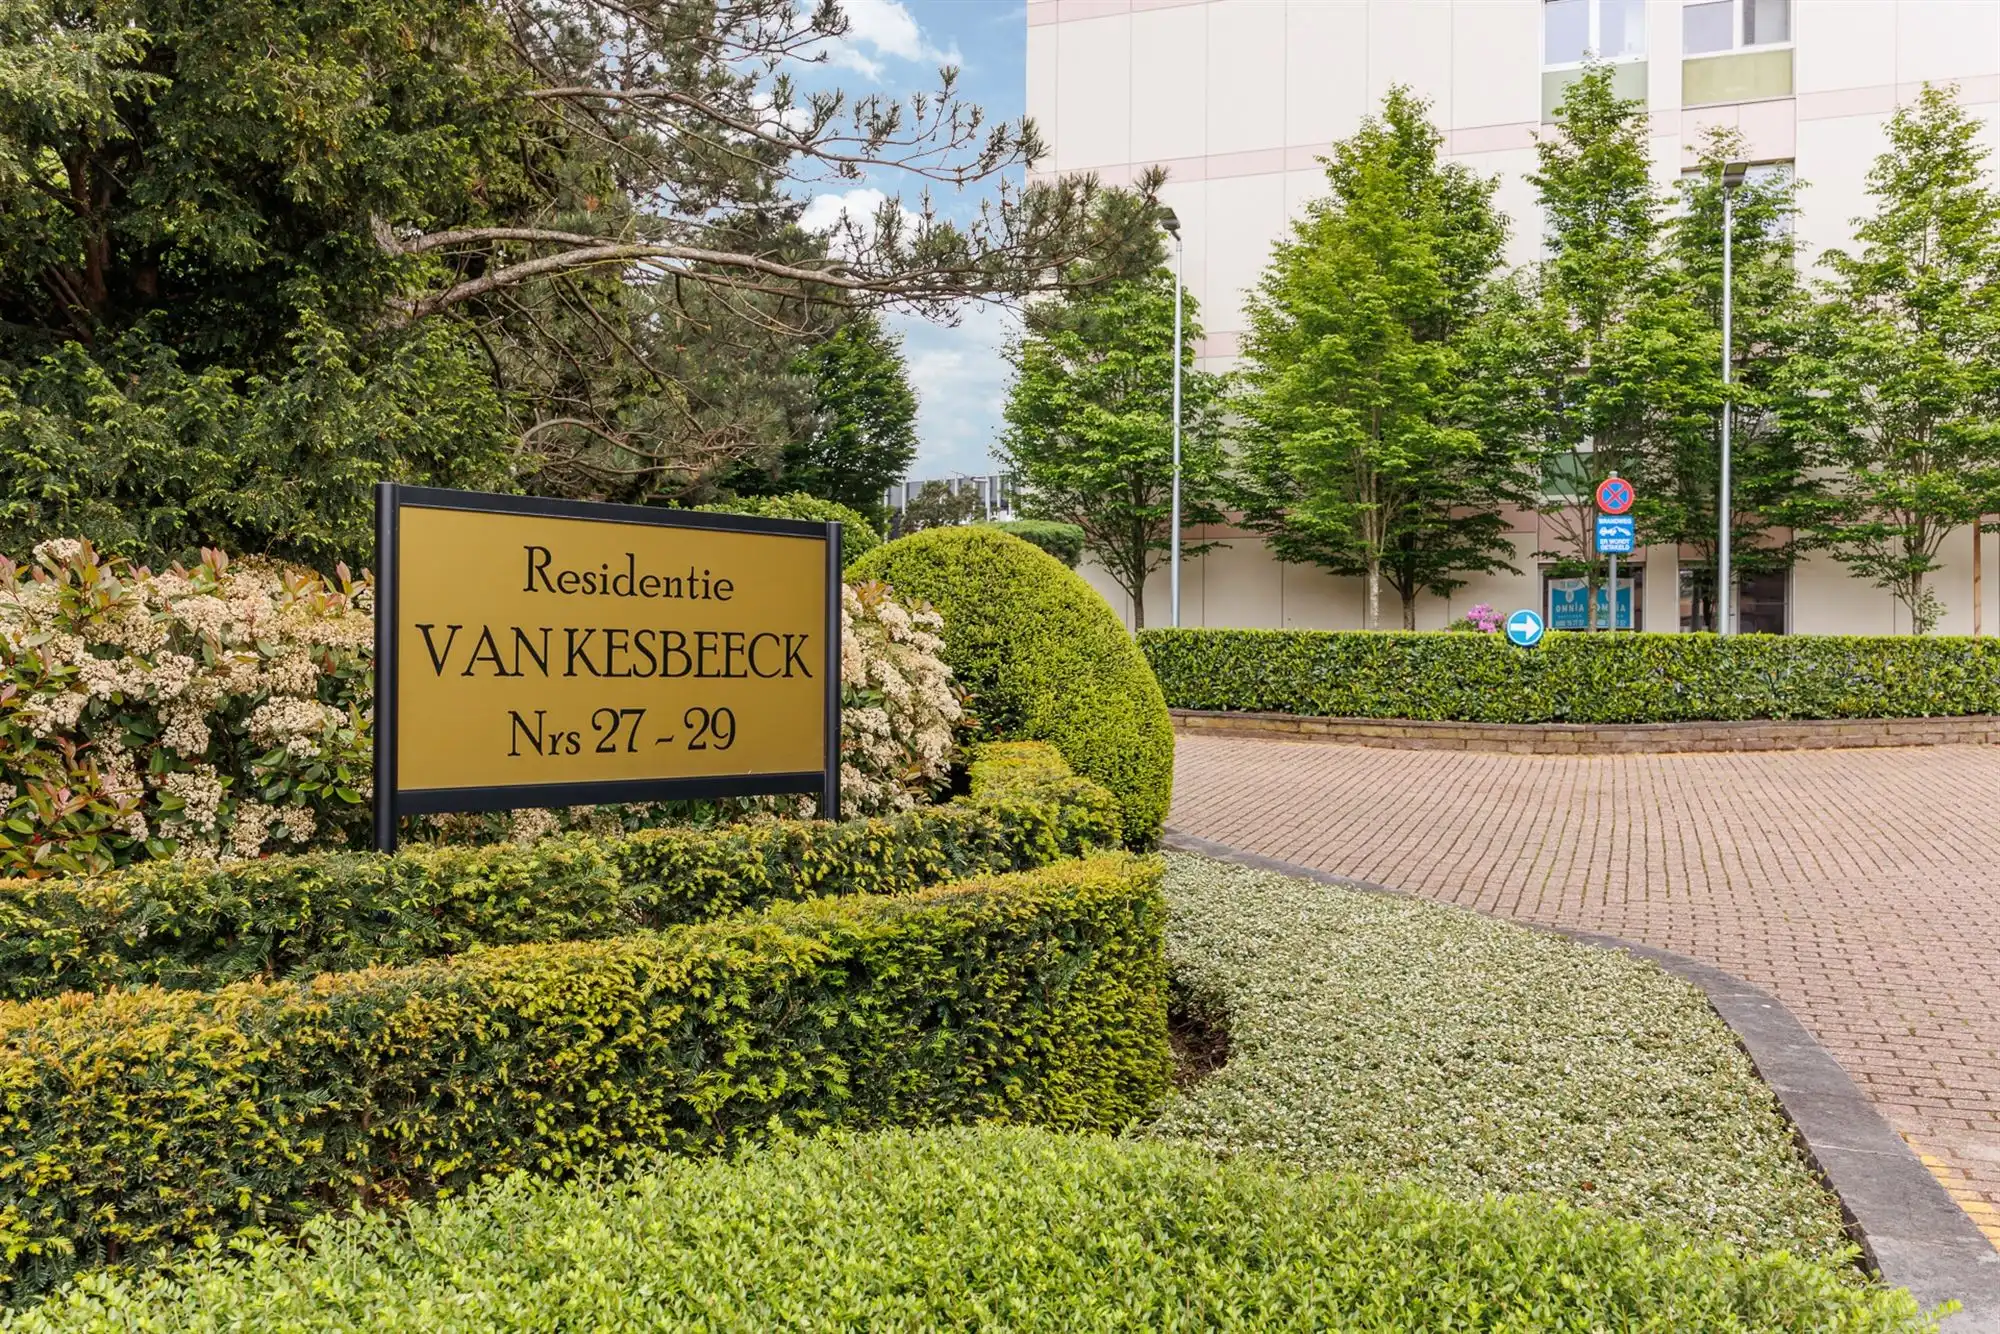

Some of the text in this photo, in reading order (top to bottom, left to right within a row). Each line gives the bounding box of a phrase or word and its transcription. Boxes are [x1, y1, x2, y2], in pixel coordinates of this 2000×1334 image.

[522, 545, 734, 601] Residentie
[507, 710, 581, 757] Nrs
[591, 707, 647, 754] 27
[683, 706, 736, 751] 29
